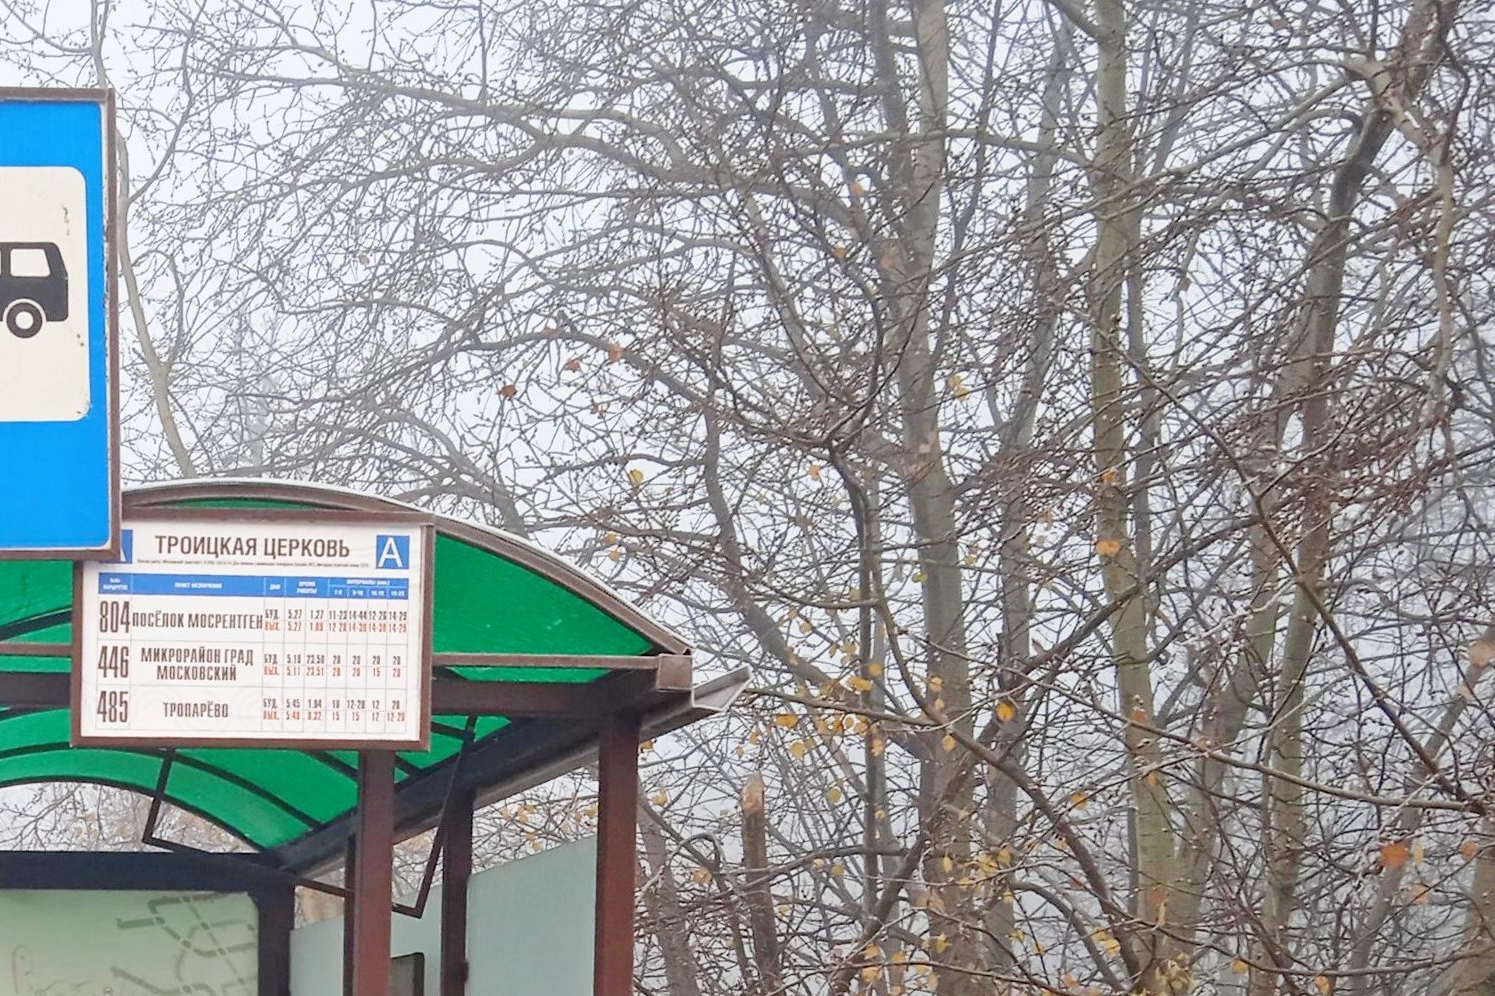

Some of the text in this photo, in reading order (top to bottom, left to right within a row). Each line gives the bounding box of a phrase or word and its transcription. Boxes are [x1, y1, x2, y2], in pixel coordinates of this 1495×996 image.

[155, 535, 350, 559] ТРОИЦКАЯ ЦЕРКОВЬ
[378, 537, 403, 568] А
[99, 600, 263, 633] 804 ПОСЁЛОК МОСРЕНТГЕН
[98, 645, 254, 678] 446 МИКРОРАЙОН ГРАД
[156, 664, 237, 680] МОСКОВСКИЙ
[97, 690, 229, 723] 485 ТРОПАРЁВО
